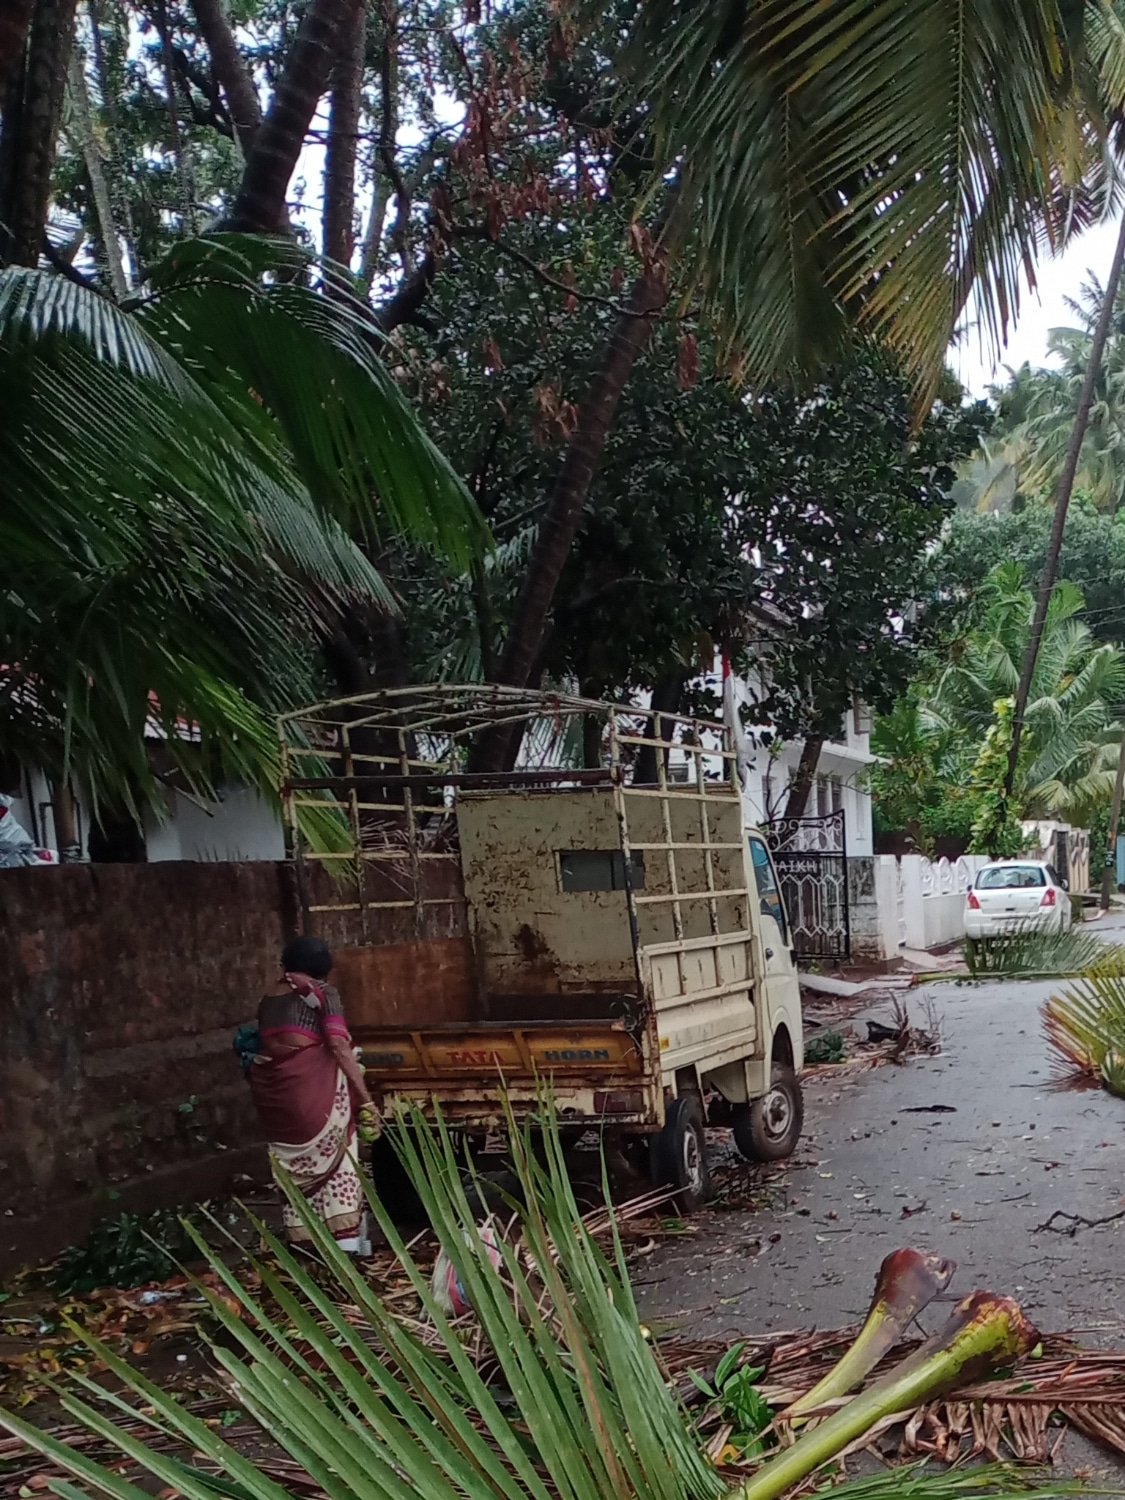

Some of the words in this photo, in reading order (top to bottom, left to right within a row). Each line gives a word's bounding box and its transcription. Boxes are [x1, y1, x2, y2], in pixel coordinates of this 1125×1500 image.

[774, 860, 818, 873] AIKH
[445, 1050, 505, 1065] TATA
[544, 1049, 610, 1061] HORN
